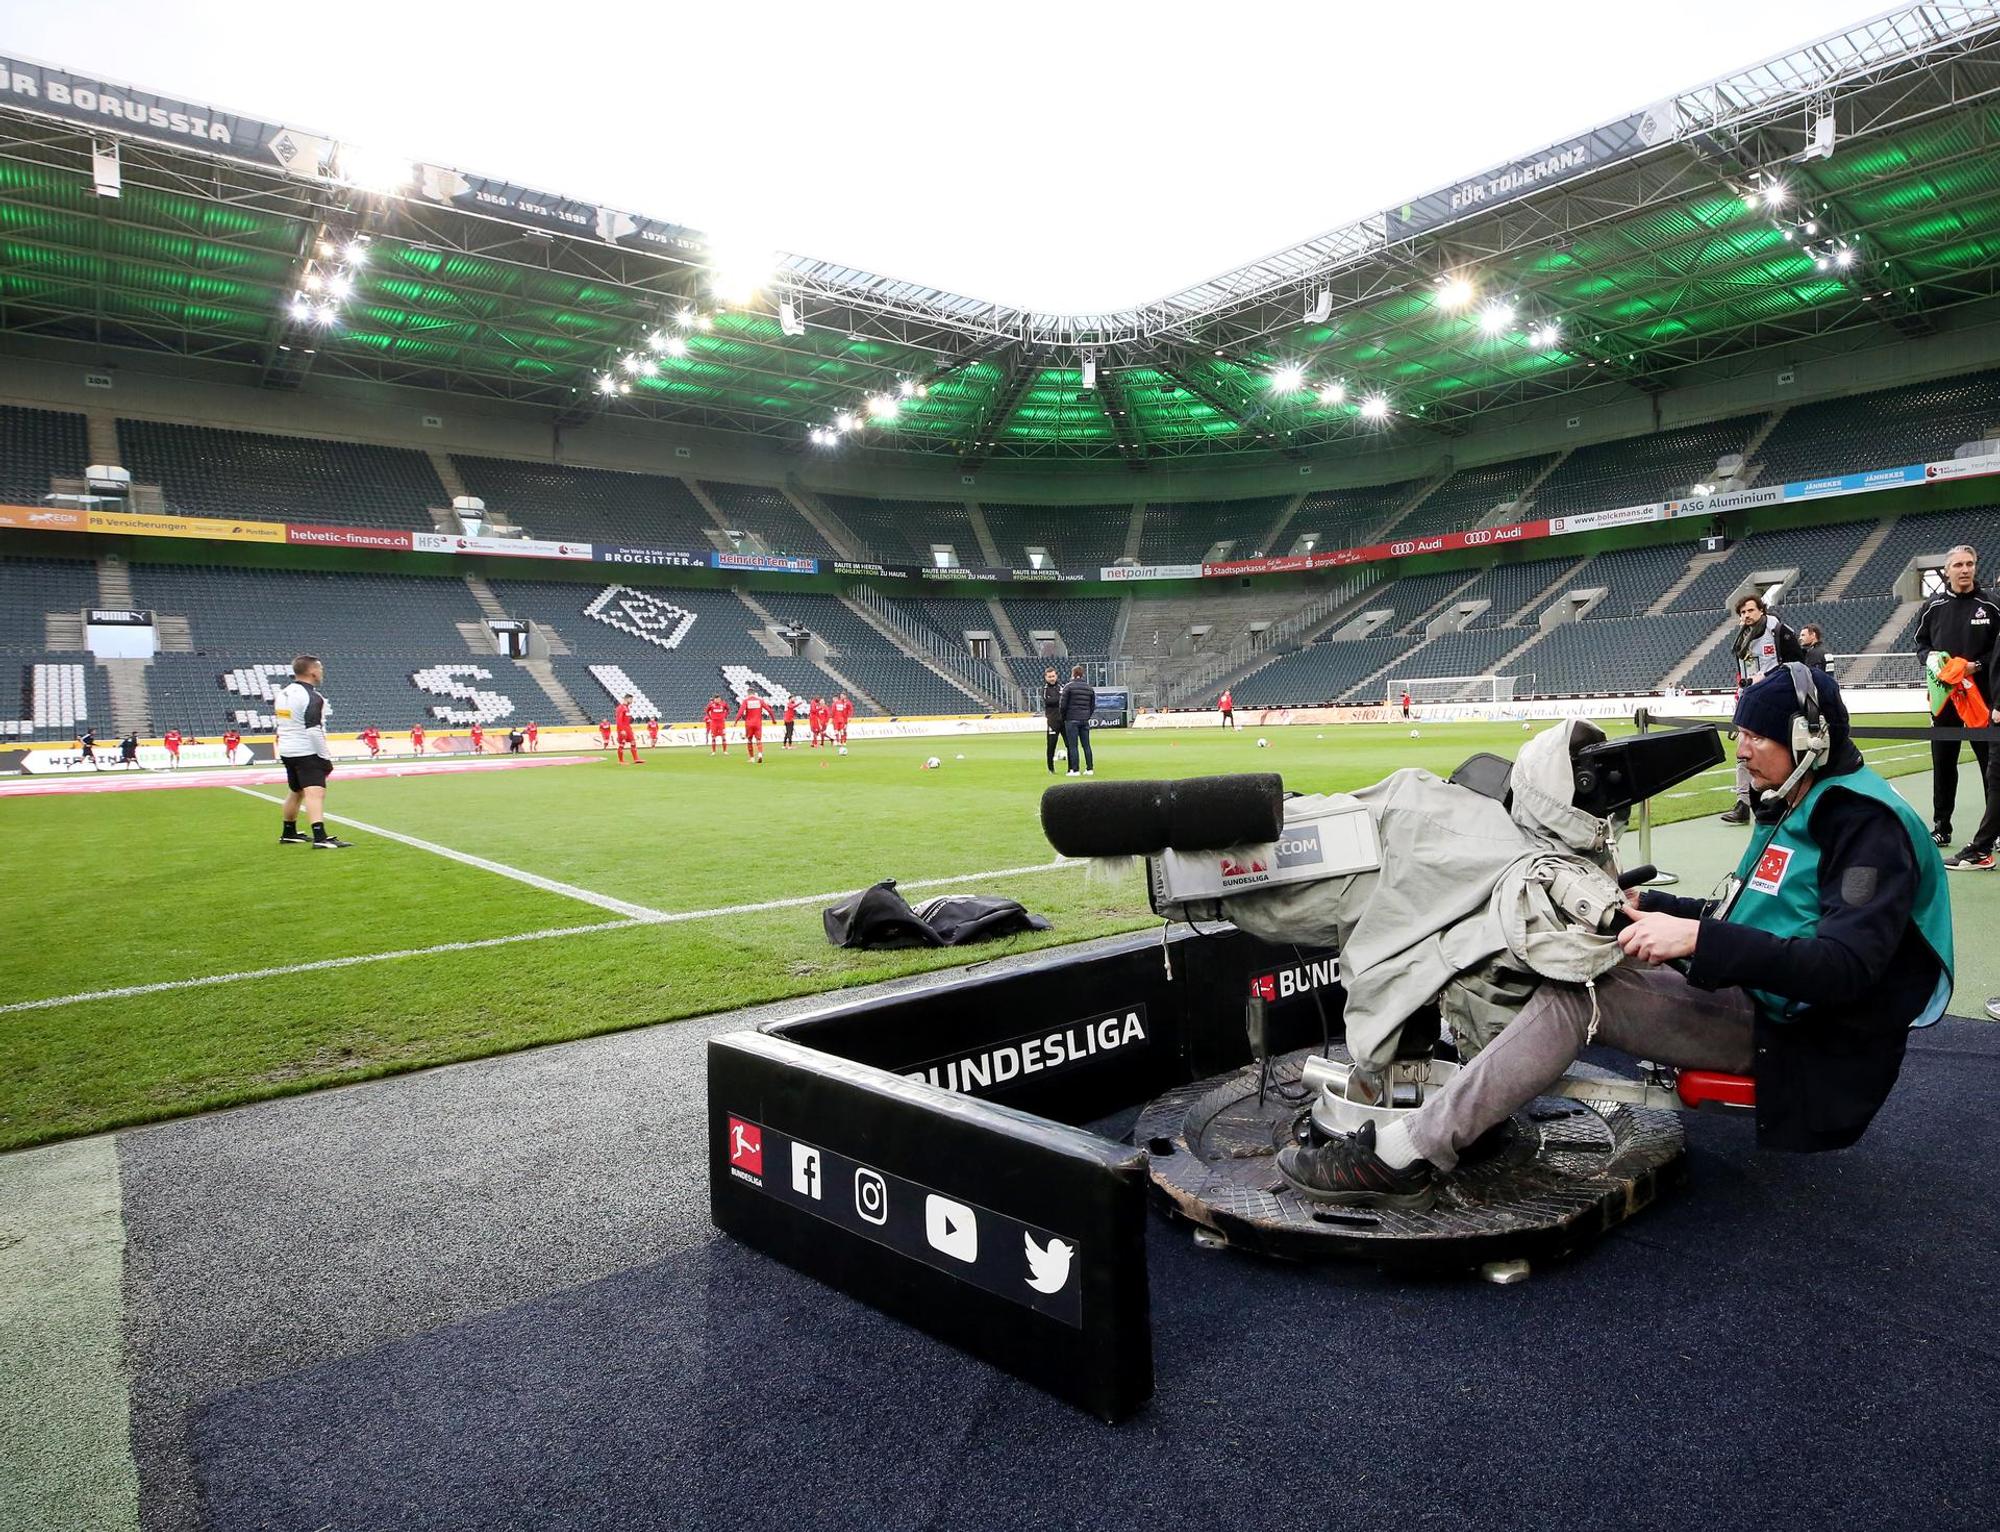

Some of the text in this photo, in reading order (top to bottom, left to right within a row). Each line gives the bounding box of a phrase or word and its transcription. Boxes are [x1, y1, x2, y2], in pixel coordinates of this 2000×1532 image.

[48, 81, 232, 144] BORUSSIA
[1452, 146, 1585, 209] FÜR TOLERANZ
[1681, 491, 1776, 513] ASG Aluminium
[1574, 507, 1654, 525] www.bolckmans.de
[90, 517, 103, 525] PB
[107, 518, 187, 531] Versicherungen
[291, 529, 408, 546] helvetic-finance.ch
[1494, 527, 1522, 540] Audi
[419, 537, 440, 548] HFS
[1417, 538, 1442, 551] Audi
[604, 553, 704, 567] BROGSITTER.de
[719, 553, 765, 566] Heinrich
[1107, 567, 1157, 579] netpoint
[1213, 564, 1266, 575] Stadtsparkasse
[92, 610, 131, 621] PUMA
[1100, 719, 1120, 727] Audi
[1222, 873, 1269, 887] BUNDESLIGA
[1278, 957, 1341, 998] BUND
[731, 1167, 763, 1188] BUNDESLIGA
